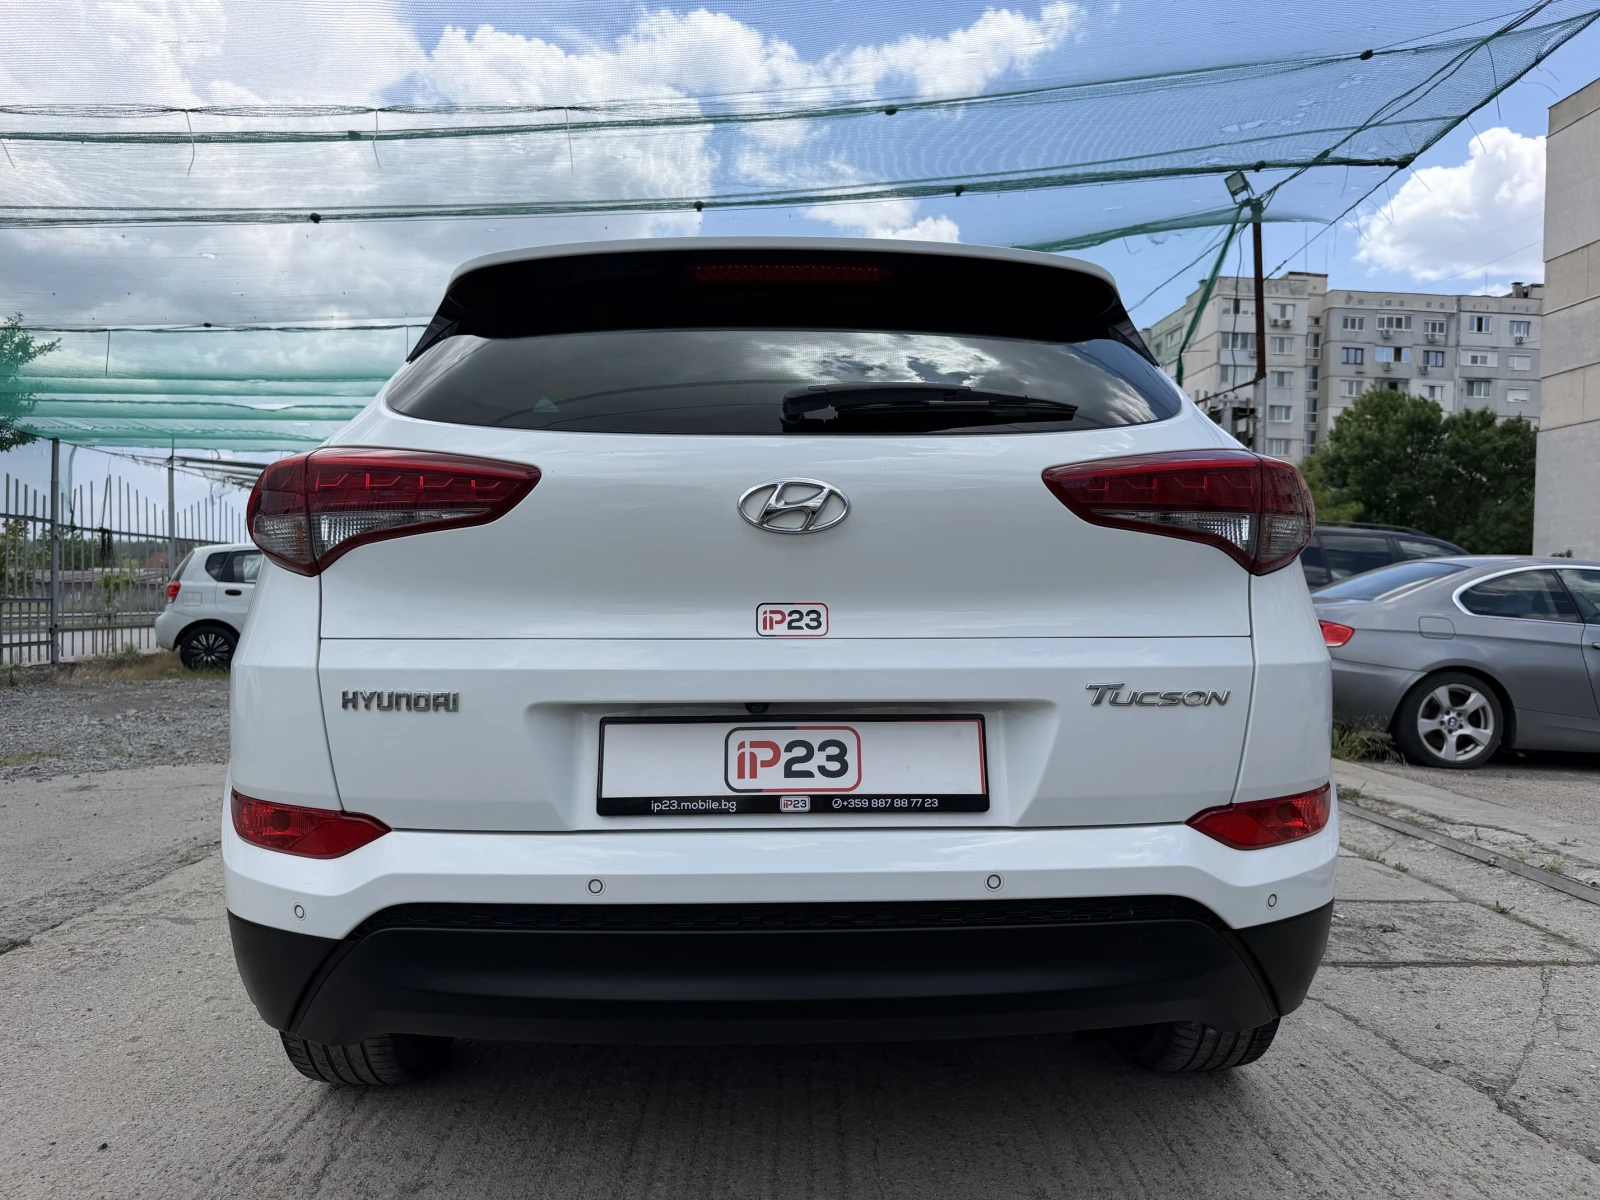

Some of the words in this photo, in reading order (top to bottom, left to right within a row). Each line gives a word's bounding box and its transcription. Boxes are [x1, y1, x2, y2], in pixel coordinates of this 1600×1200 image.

[762, 609, 822, 631] iP23
[341, 690, 460, 712] HYUNDAI
[736, 739, 849, 780] iP23
[650, 799, 737, 813] ip23.mobile.bg
[782, 799, 808, 810] iP23
[842, 798, 869, 808] +359
[871, 798, 892, 808] 887
[893, 798, 909, 808] 88
[910, 798, 923, 808] 77
[924, 798, 939, 808] 23
